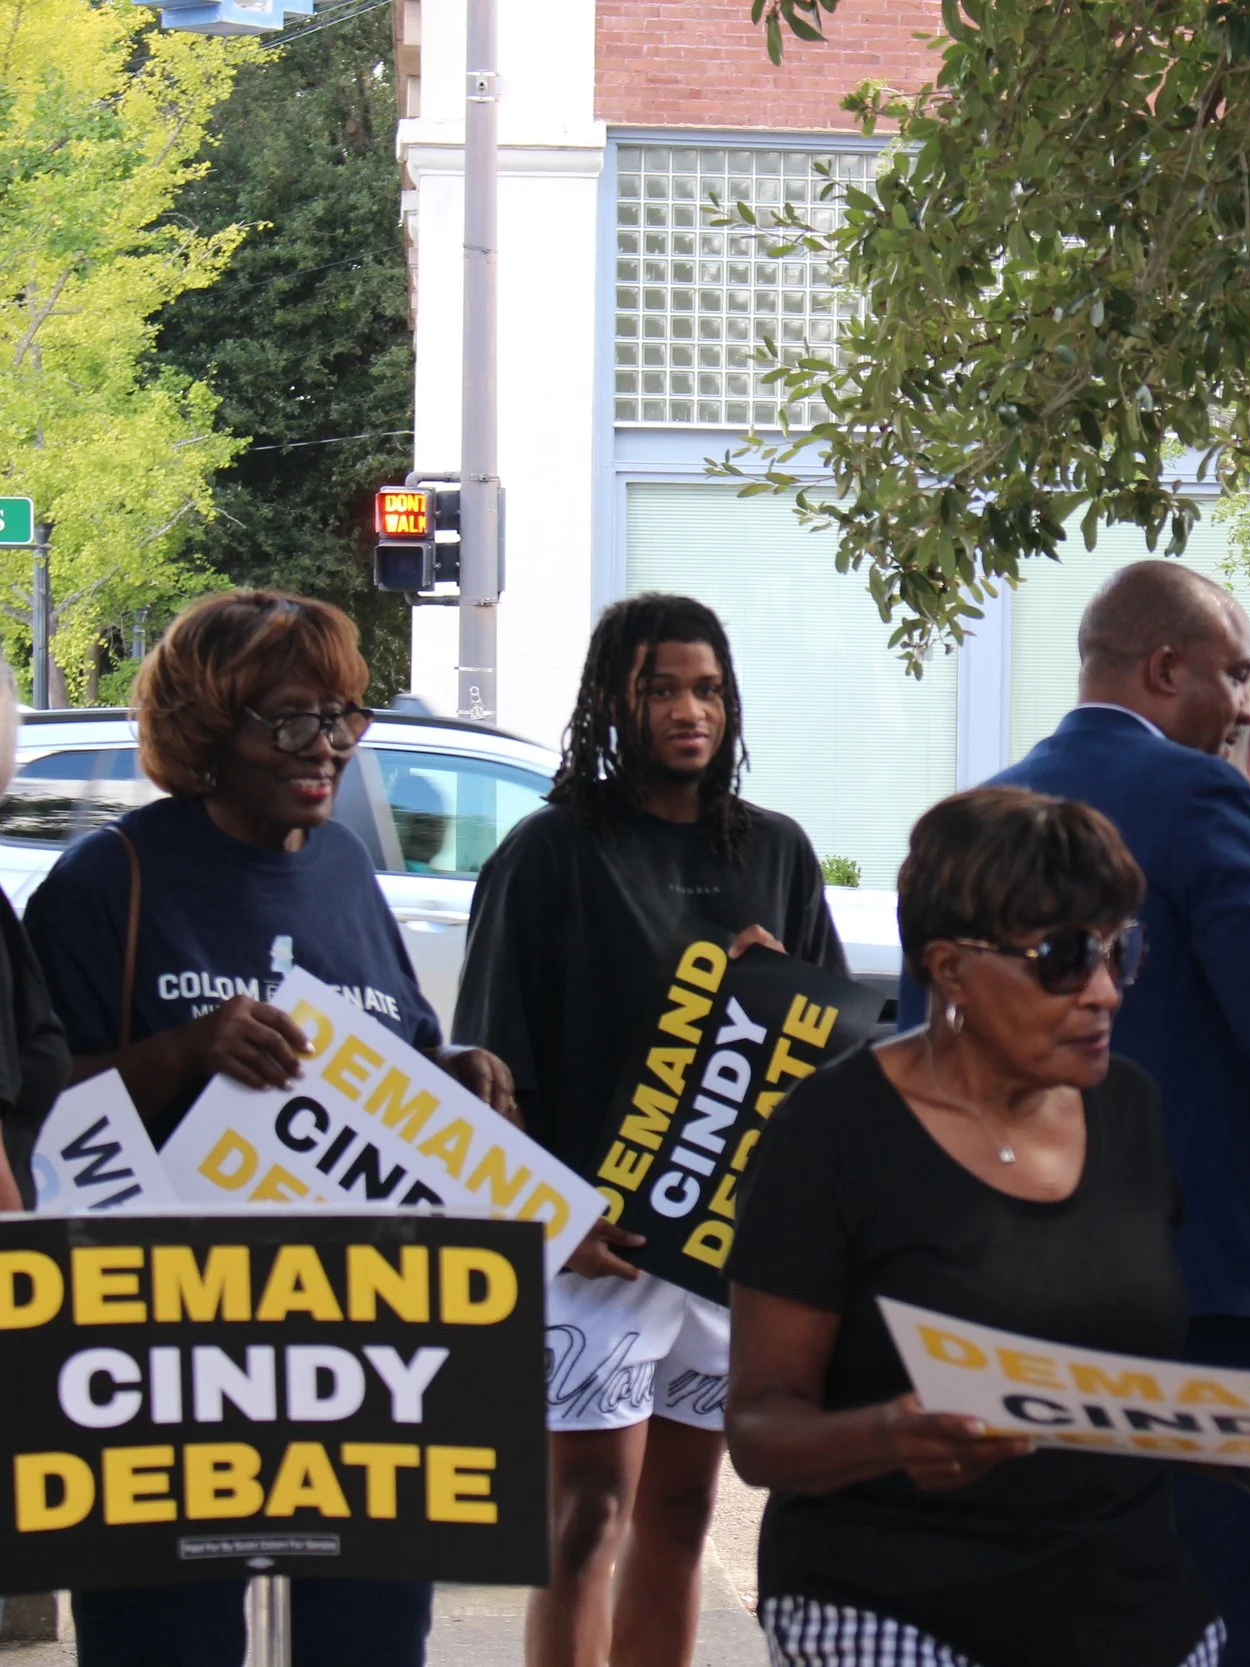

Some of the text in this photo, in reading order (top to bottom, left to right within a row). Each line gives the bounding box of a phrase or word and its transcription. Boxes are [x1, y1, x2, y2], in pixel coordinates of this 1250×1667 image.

[158, 972, 260, 1001] COLOM
[289, 999, 570, 1241] DEMAND
[651, 996, 768, 1219] CINDY
[0, 1244, 519, 1331] DEMAND
[57, 1344, 451, 1429] CINDY
[13, 1441, 498, 1533] DEBATE
